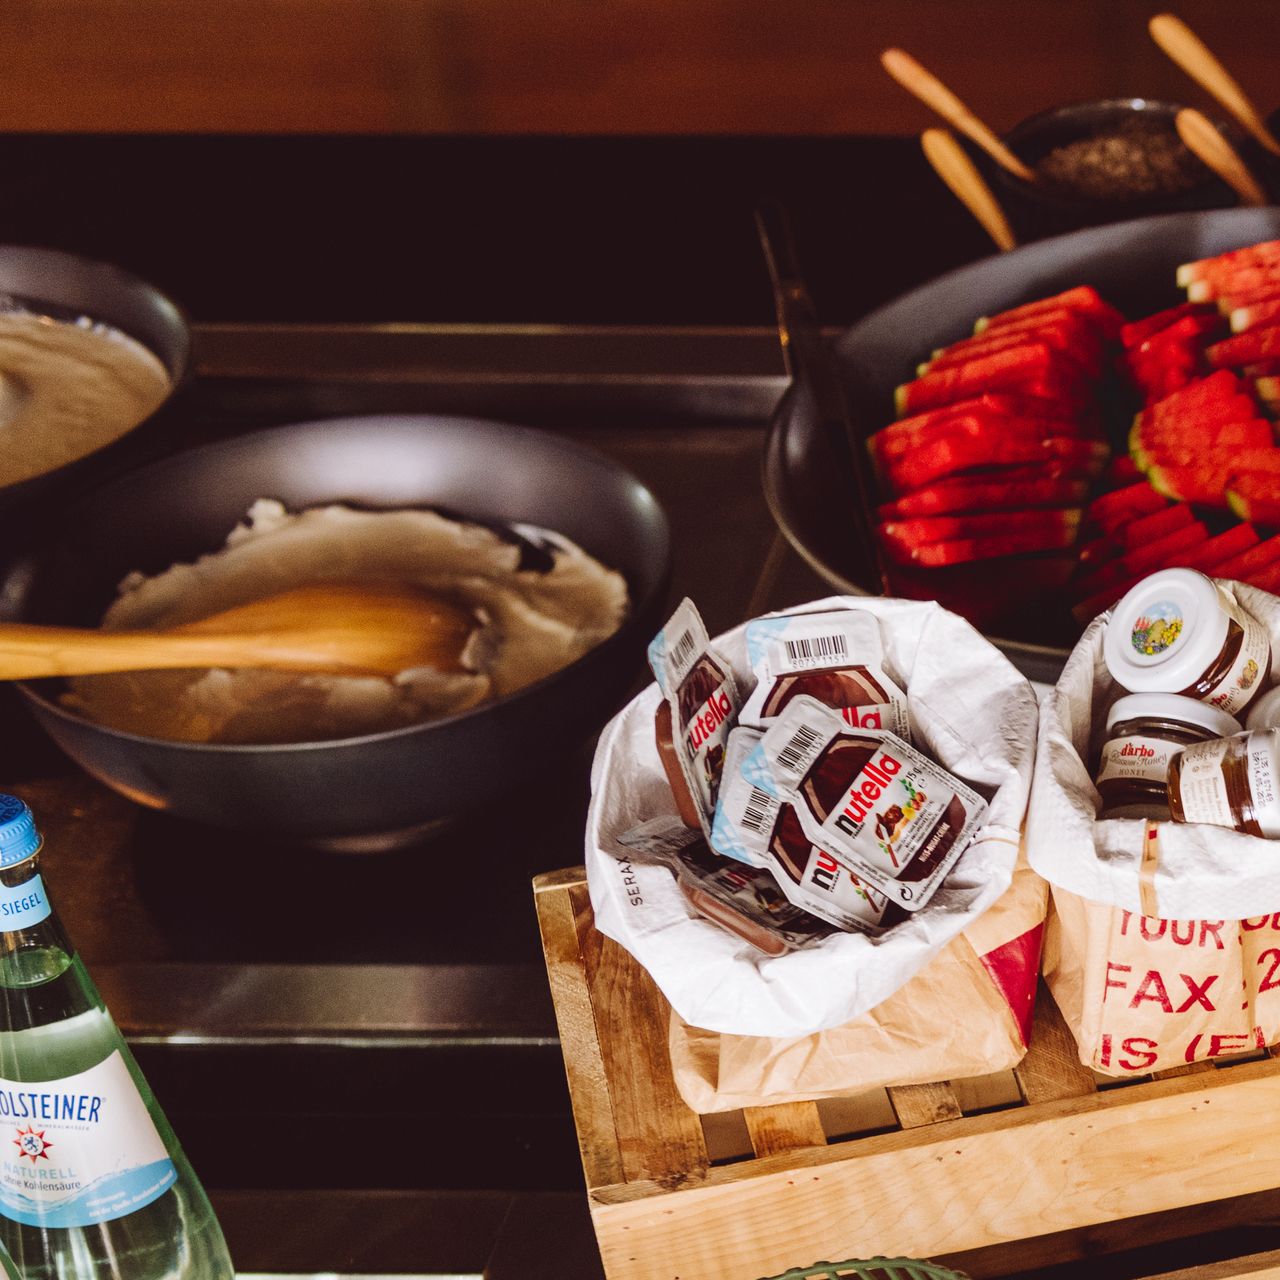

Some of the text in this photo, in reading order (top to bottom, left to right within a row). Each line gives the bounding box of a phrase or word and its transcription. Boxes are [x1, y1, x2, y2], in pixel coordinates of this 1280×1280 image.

[686, 691, 732, 762] nutella
[834, 753, 903, 837] nutella
[1, 892, 42, 916] SIEGEL
[616, 855, 643, 907] SERAX
[1105, 960, 1220, 1014] FAX
[0, 1090, 102, 1123] OLSTEINER
[3, 1162, 77, 1180] NATURELL
